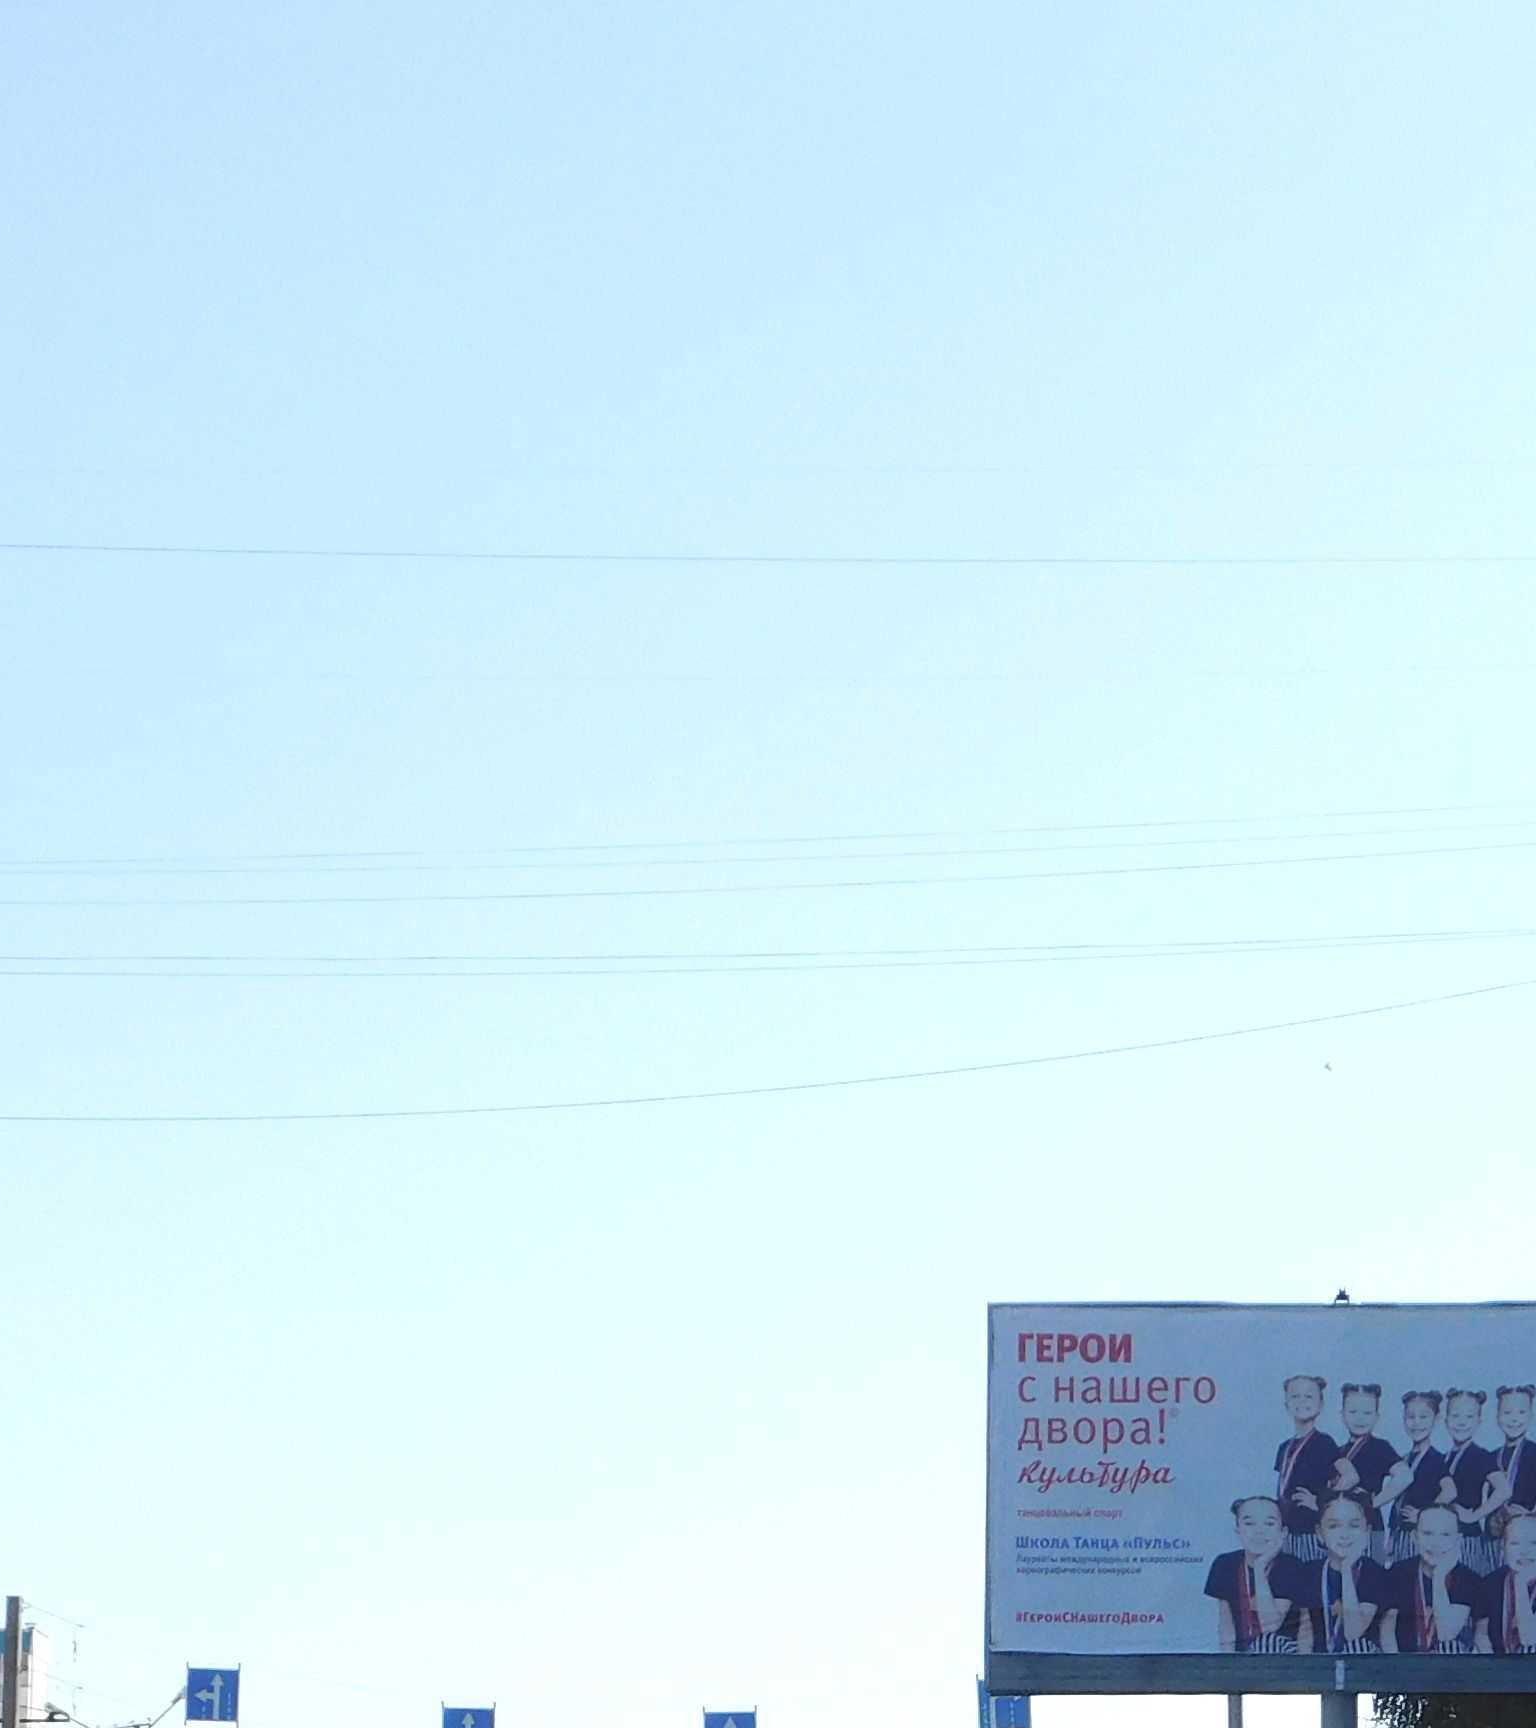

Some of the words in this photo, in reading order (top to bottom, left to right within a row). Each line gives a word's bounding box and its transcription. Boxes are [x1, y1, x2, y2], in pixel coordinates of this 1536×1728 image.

[1017, 1333, 1132, 1364] ГЕРОИ
[1017, 1375, 1037, 1404] с
[1053, 1375, 1217, 1404] нашего
[1017, 1407, 1166, 1454] двора!
